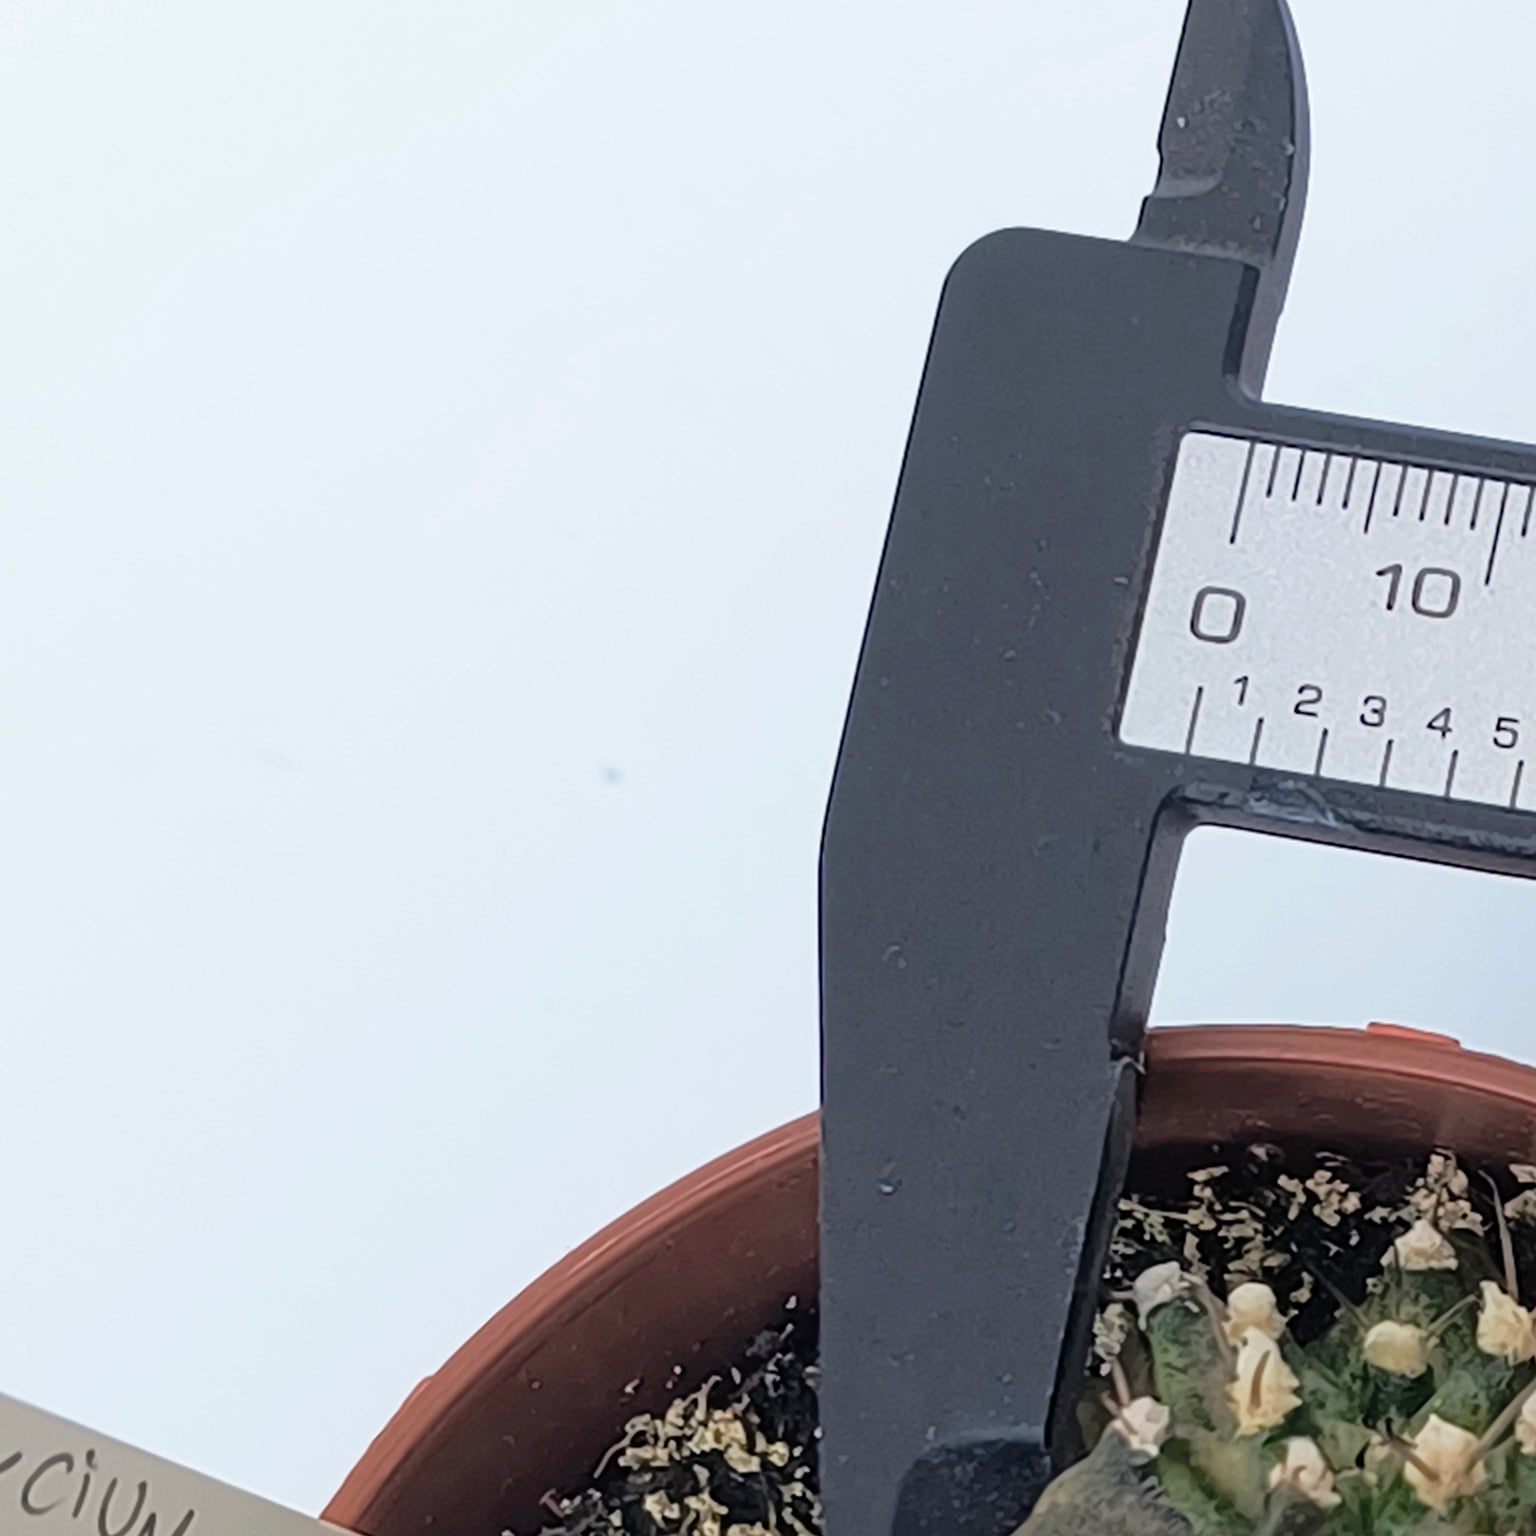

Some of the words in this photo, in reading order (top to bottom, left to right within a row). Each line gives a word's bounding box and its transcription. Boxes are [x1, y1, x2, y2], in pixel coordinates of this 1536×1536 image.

[1189, 586, 1246, 645] 0
[1374, 562, 1461, 619] 10
[1234, 675, 1249, 706] 1
[1293, 683, 1323, 718] 2
[1359, 695, 1387, 728] 3
[1426, 707, 1453, 739] 4
[1492, 716, 1520, 750] 5
